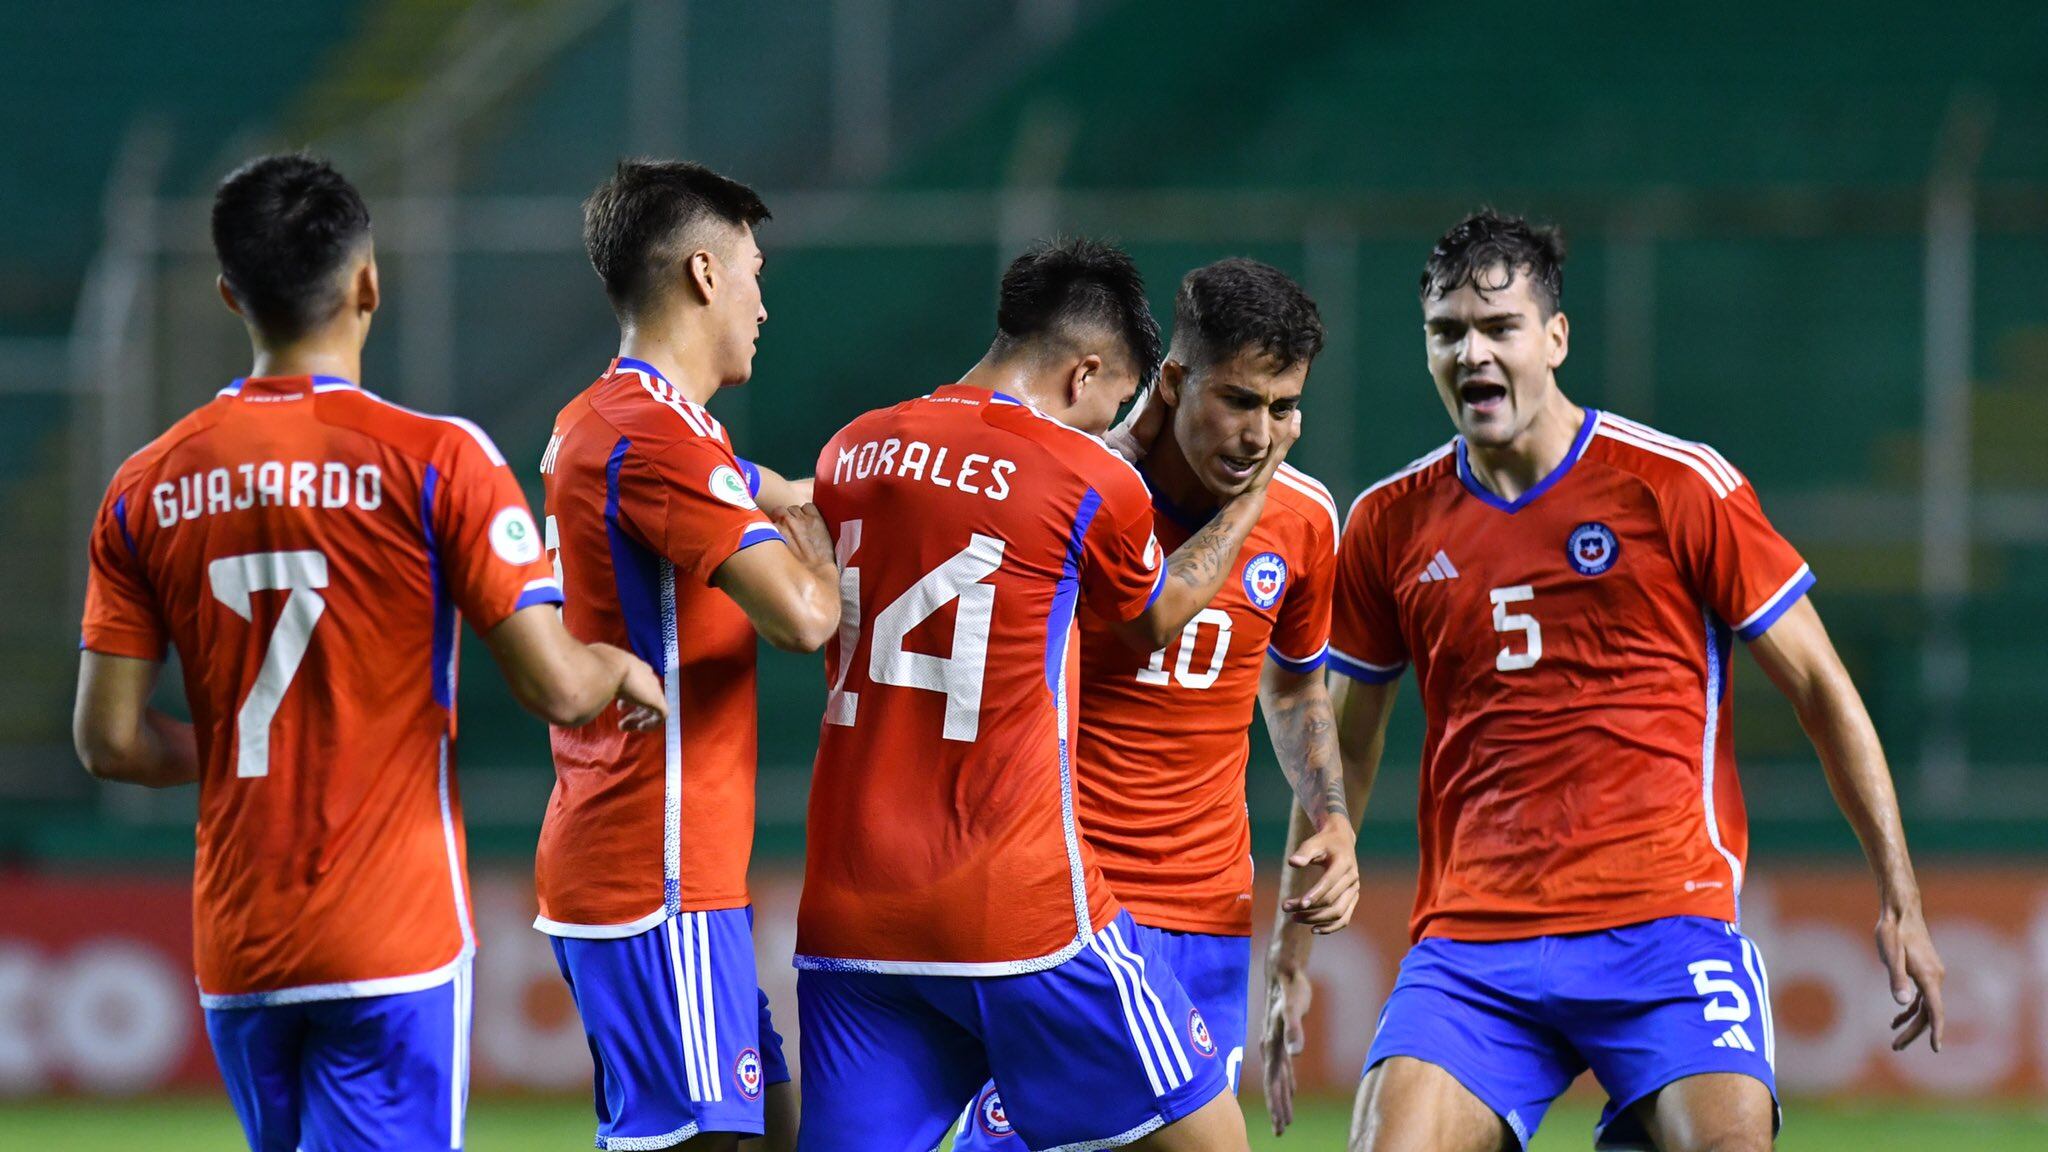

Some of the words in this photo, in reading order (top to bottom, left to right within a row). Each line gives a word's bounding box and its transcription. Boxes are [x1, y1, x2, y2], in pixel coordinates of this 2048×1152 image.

[153, 461, 382, 528] GUAJARDO
[833, 438, 1017, 501] MORALES
[208, 550, 329, 778] 7
[827, 519, 1006, 743] 14
[1489, 584, 1542, 672] 5
[1687, 959, 1752, 1023] 5
